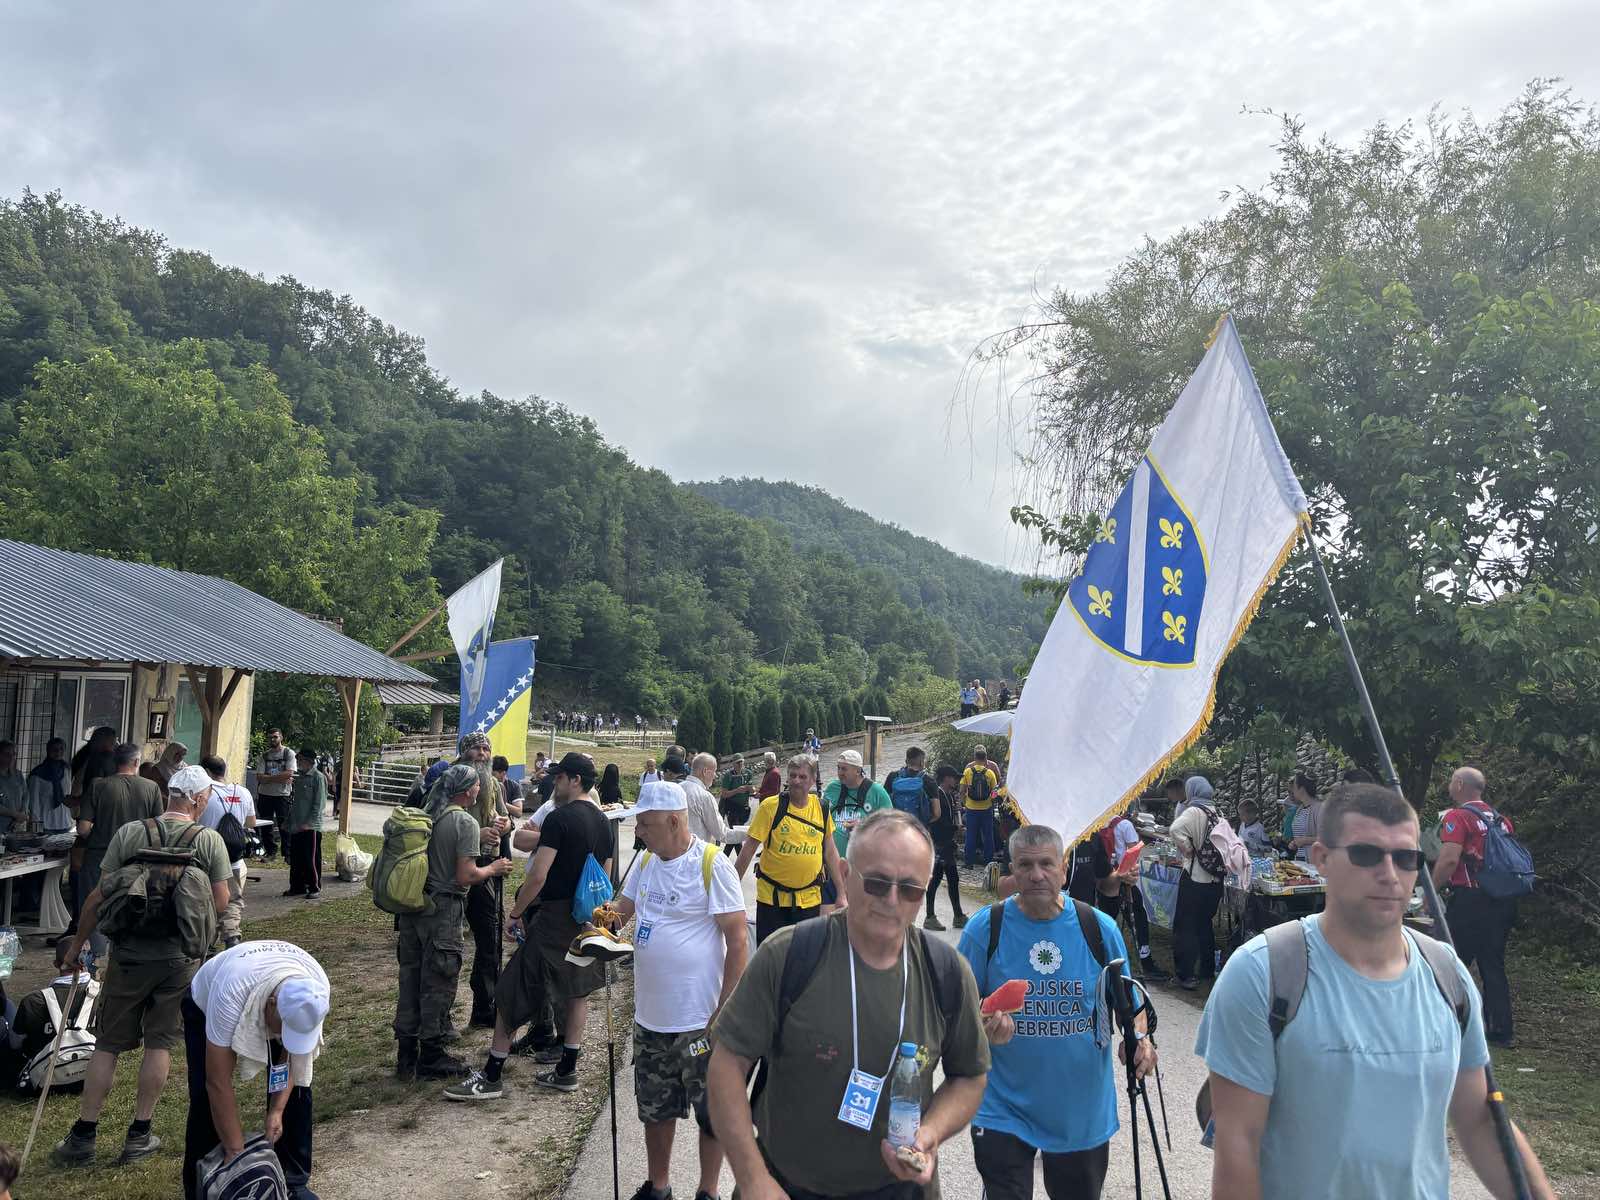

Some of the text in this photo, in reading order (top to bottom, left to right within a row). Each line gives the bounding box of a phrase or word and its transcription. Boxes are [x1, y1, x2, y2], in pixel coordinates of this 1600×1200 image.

[779, 841, 817, 855] kreka
[1024, 979, 1084, 997] OJSKE
[1015, 1016, 1096, 1037] EBRENICA
[849, 1091, 872, 1110] 31
